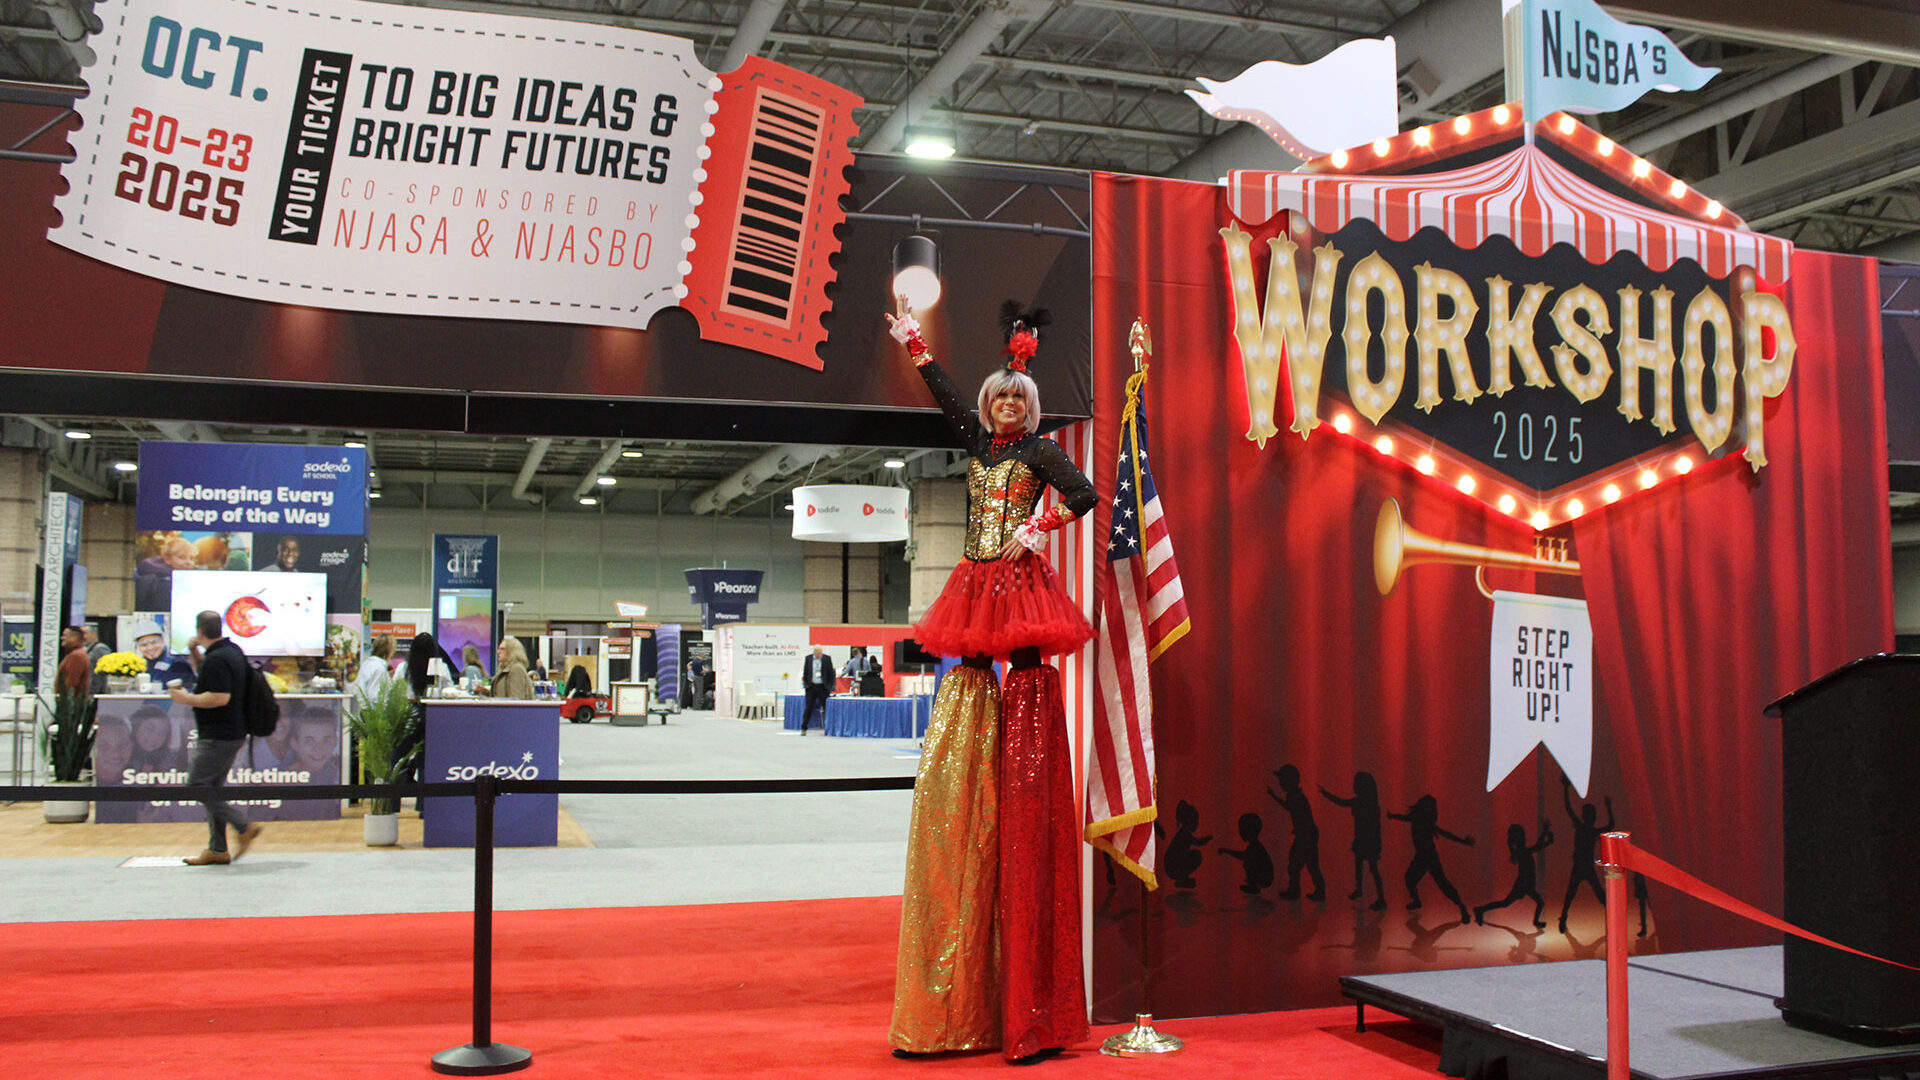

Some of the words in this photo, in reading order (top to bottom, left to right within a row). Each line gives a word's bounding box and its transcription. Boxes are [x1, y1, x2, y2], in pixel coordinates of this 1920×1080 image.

[141, 15, 268, 101] OCT.
[1542, 9, 1666, 86] NJSBA'S
[298, 59, 342, 159] TICKET
[360, 63, 414, 112] TO
[427, 70, 499, 118] BIG
[512, 77, 637, 131] IDEAS
[650, 93, 679, 137] &
[127, 107, 253, 172] 20-23
[349, 117, 491, 167] BRIGHT
[500, 130, 671, 184] FUTURES
[115, 152, 244, 227] 2025
[280, 165, 320, 236] YOUR
[340, 177, 598, 217] CO-SPONSORED
[626, 201, 659, 223] BY
[333, 208, 449, 255] NJASA
[471, 219, 494, 258] &
[515, 221, 652, 270] NJASBO
[1218, 219, 1797, 473] WORKSHOP
[303, 459, 351, 473] sodexo
[1492, 411, 1584, 464] 2025
[169, 484, 272, 505] Belonging
[277, 486, 334, 506] Every
[172, 505, 218, 525] Step
[222, 506, 243, 523] of
[246, 507, 280, 523] the
[284, 508, 330, 527] Way
[47, 495, 65, 576] ARCHITECTS
[719, 581, 757, 594] Pearson
[1517, 625, 1570, 659] STEP
[1512, 657, 1574, 692] RIGHT
[1526, 691, 1560, 724] UP!
[123, 768, 190, 785] Servin
[226, 768, 311, 784] Lifetime
